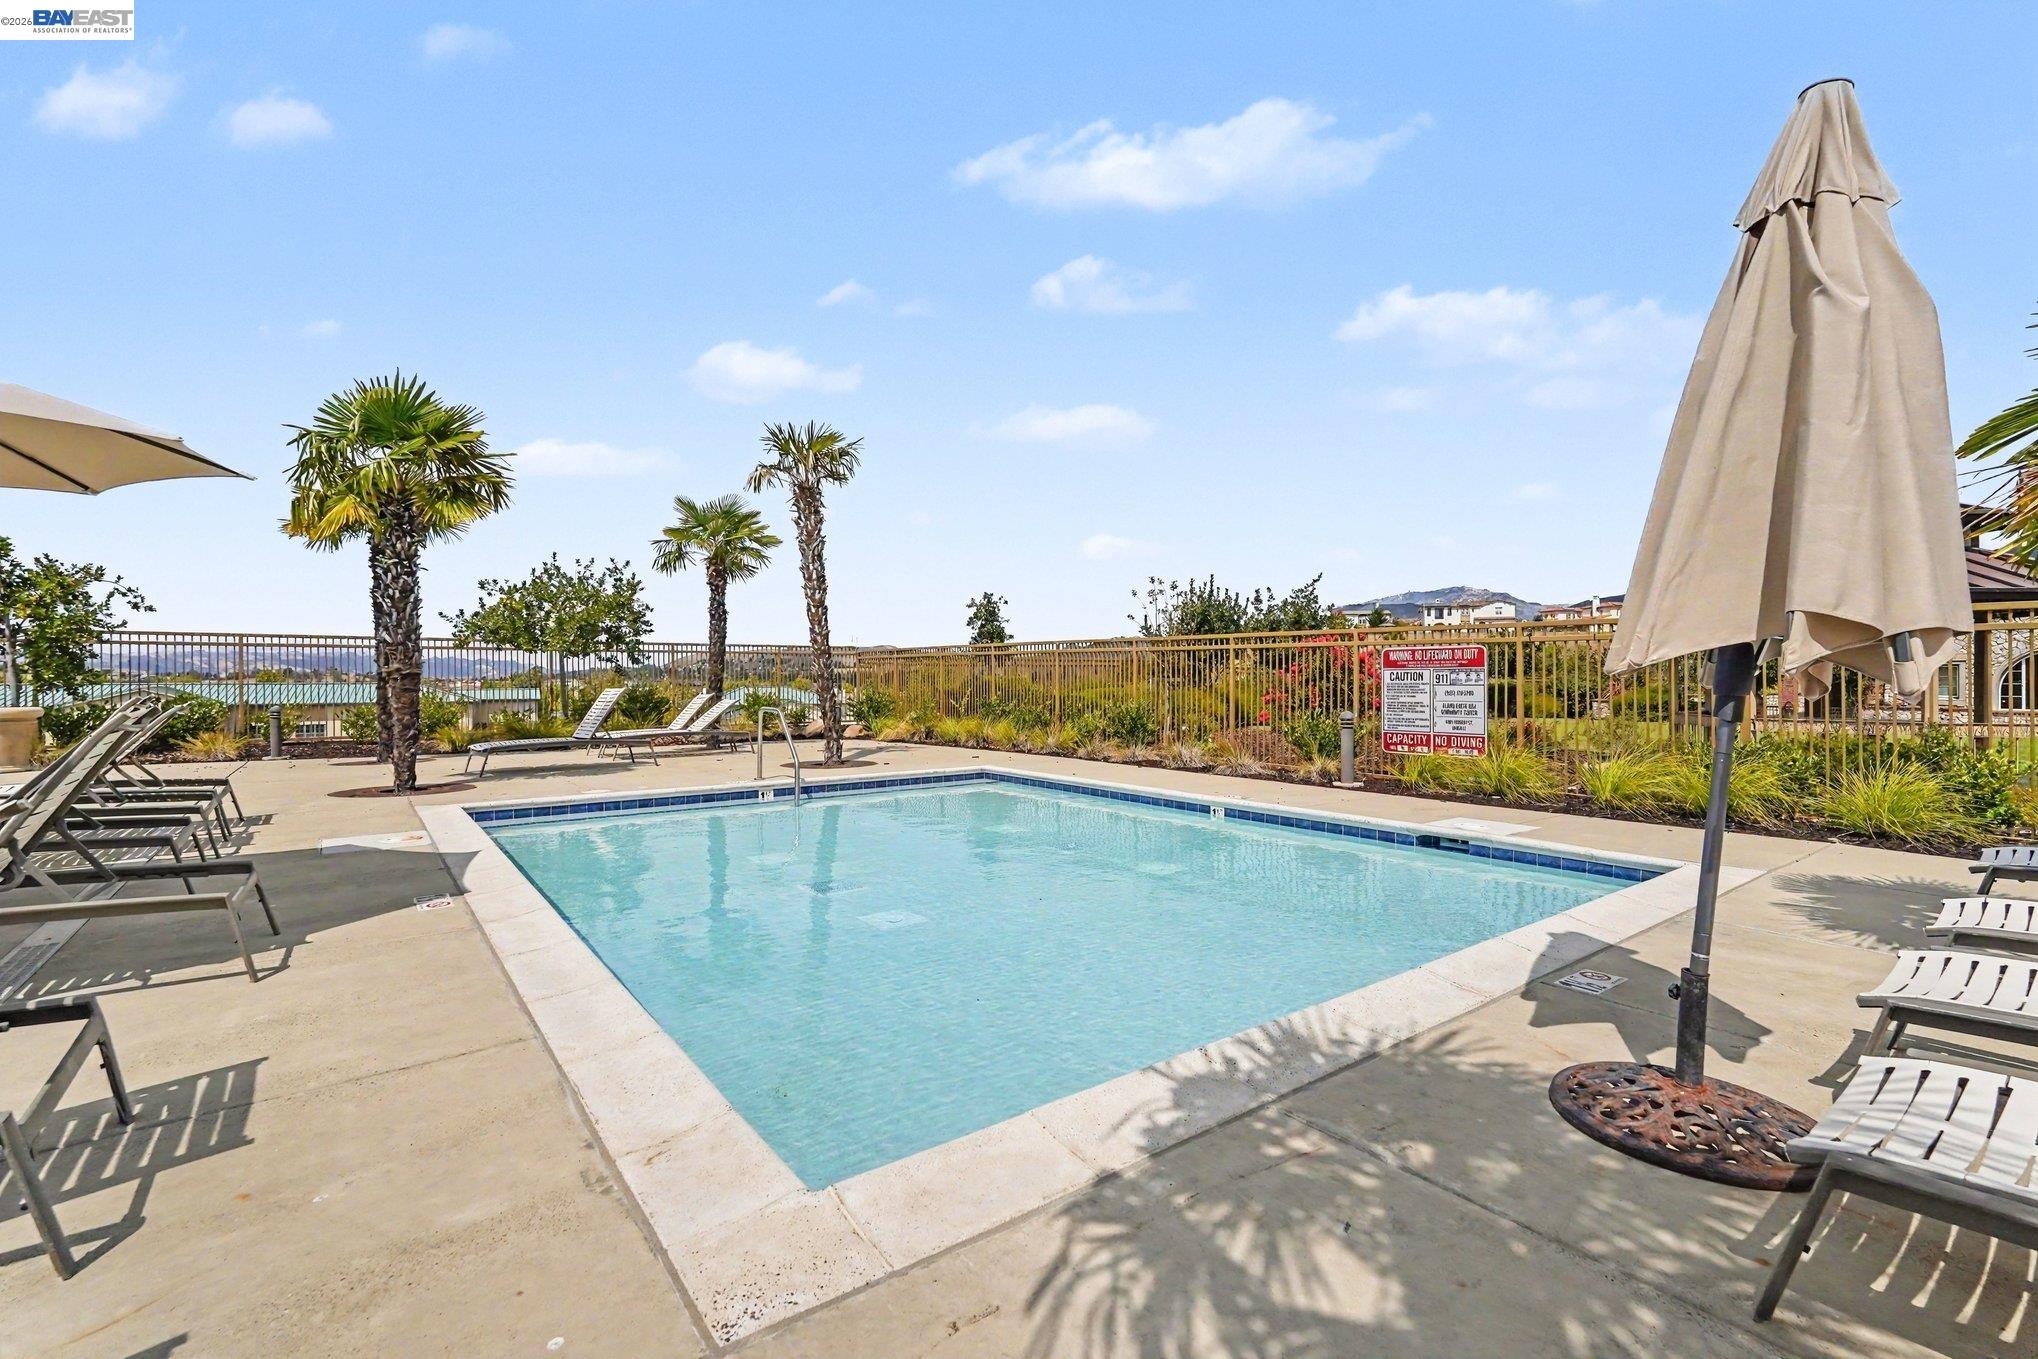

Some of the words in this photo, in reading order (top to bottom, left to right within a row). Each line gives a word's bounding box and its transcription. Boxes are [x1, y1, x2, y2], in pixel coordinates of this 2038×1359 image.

[1423, 649, 1453, 660] LIFEGUARD
[1463, 648, 1478, 659] DUTY
[1389, 671, 1424, 681] CAUTION
[1435, 673, 1449, 684] 911
[1386, 733, 1427, 745] CAPACITY
[1435, 736, 1446, 746] NO
[1451, 736, 1483, 748] DIVING
